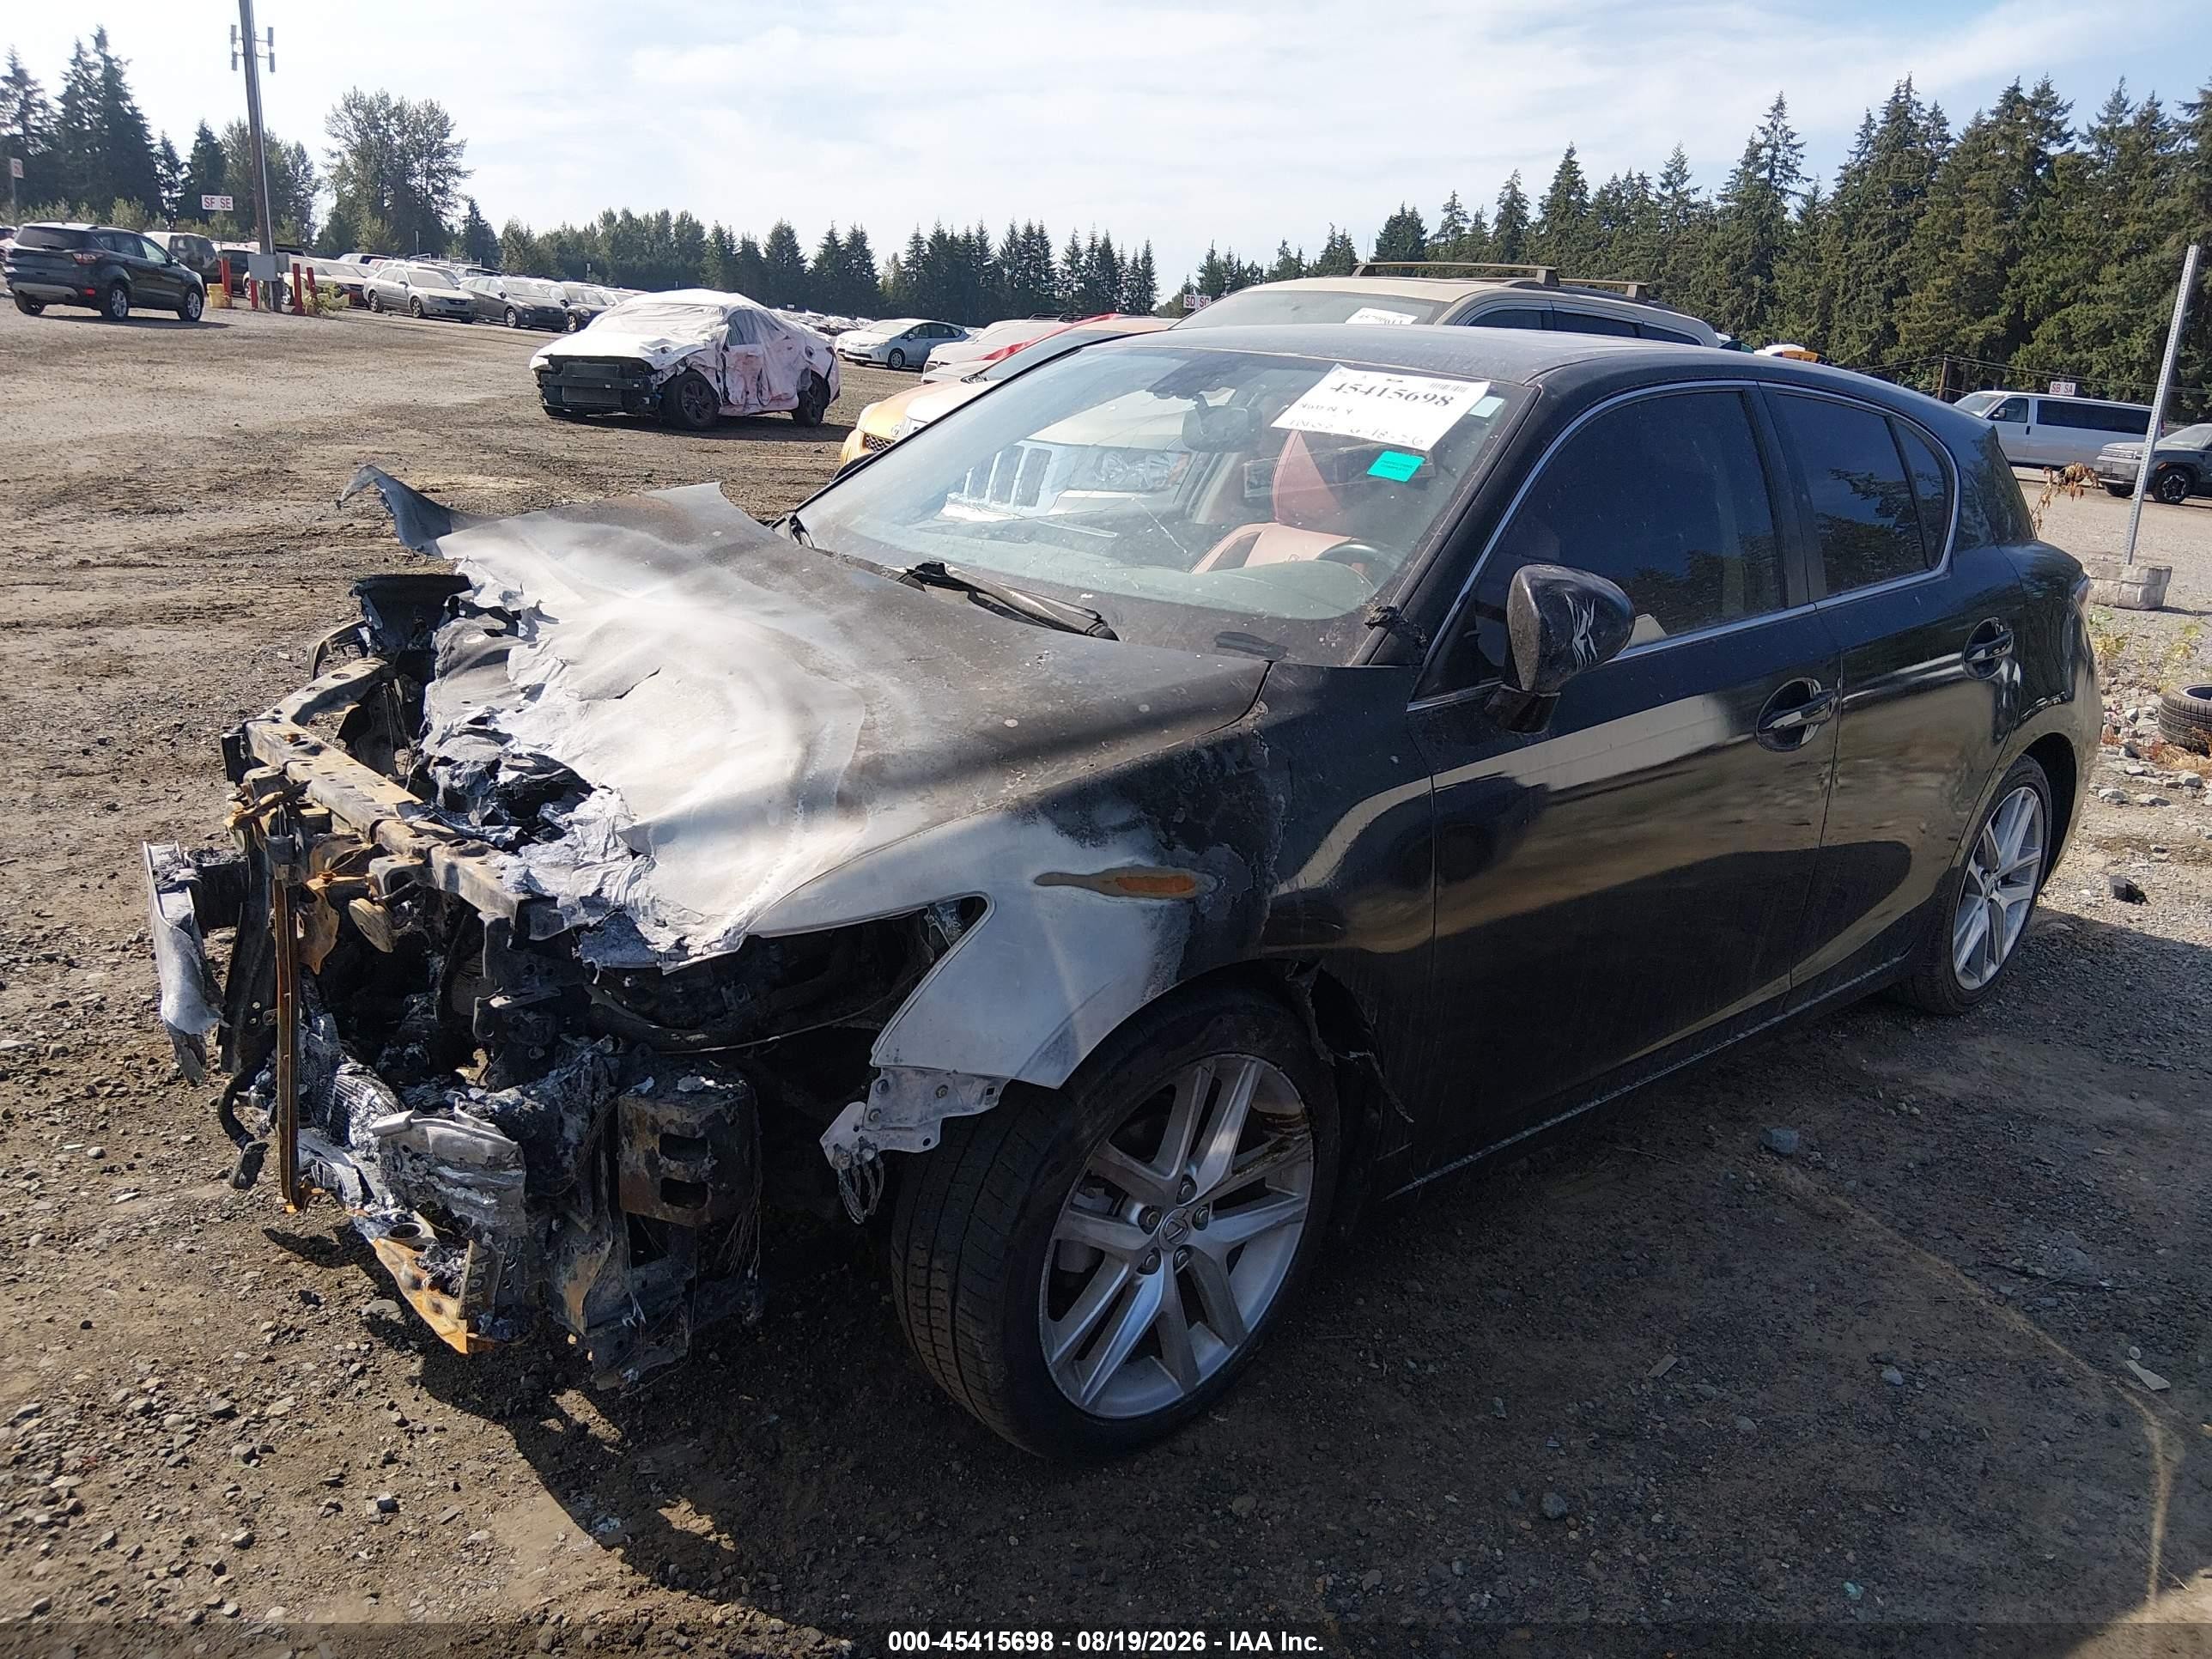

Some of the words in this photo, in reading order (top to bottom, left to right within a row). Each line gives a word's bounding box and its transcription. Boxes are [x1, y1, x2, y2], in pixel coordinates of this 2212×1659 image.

[204, 197, 215, 208] SF
[220, 198, 231, 209] SE
[1185, 295, 1195, 307] SD
[2051, 382, 2061, 393] SB
[2063, 384, 2073, 394] SA
[1330, 382, 1454, 407] 45415698
